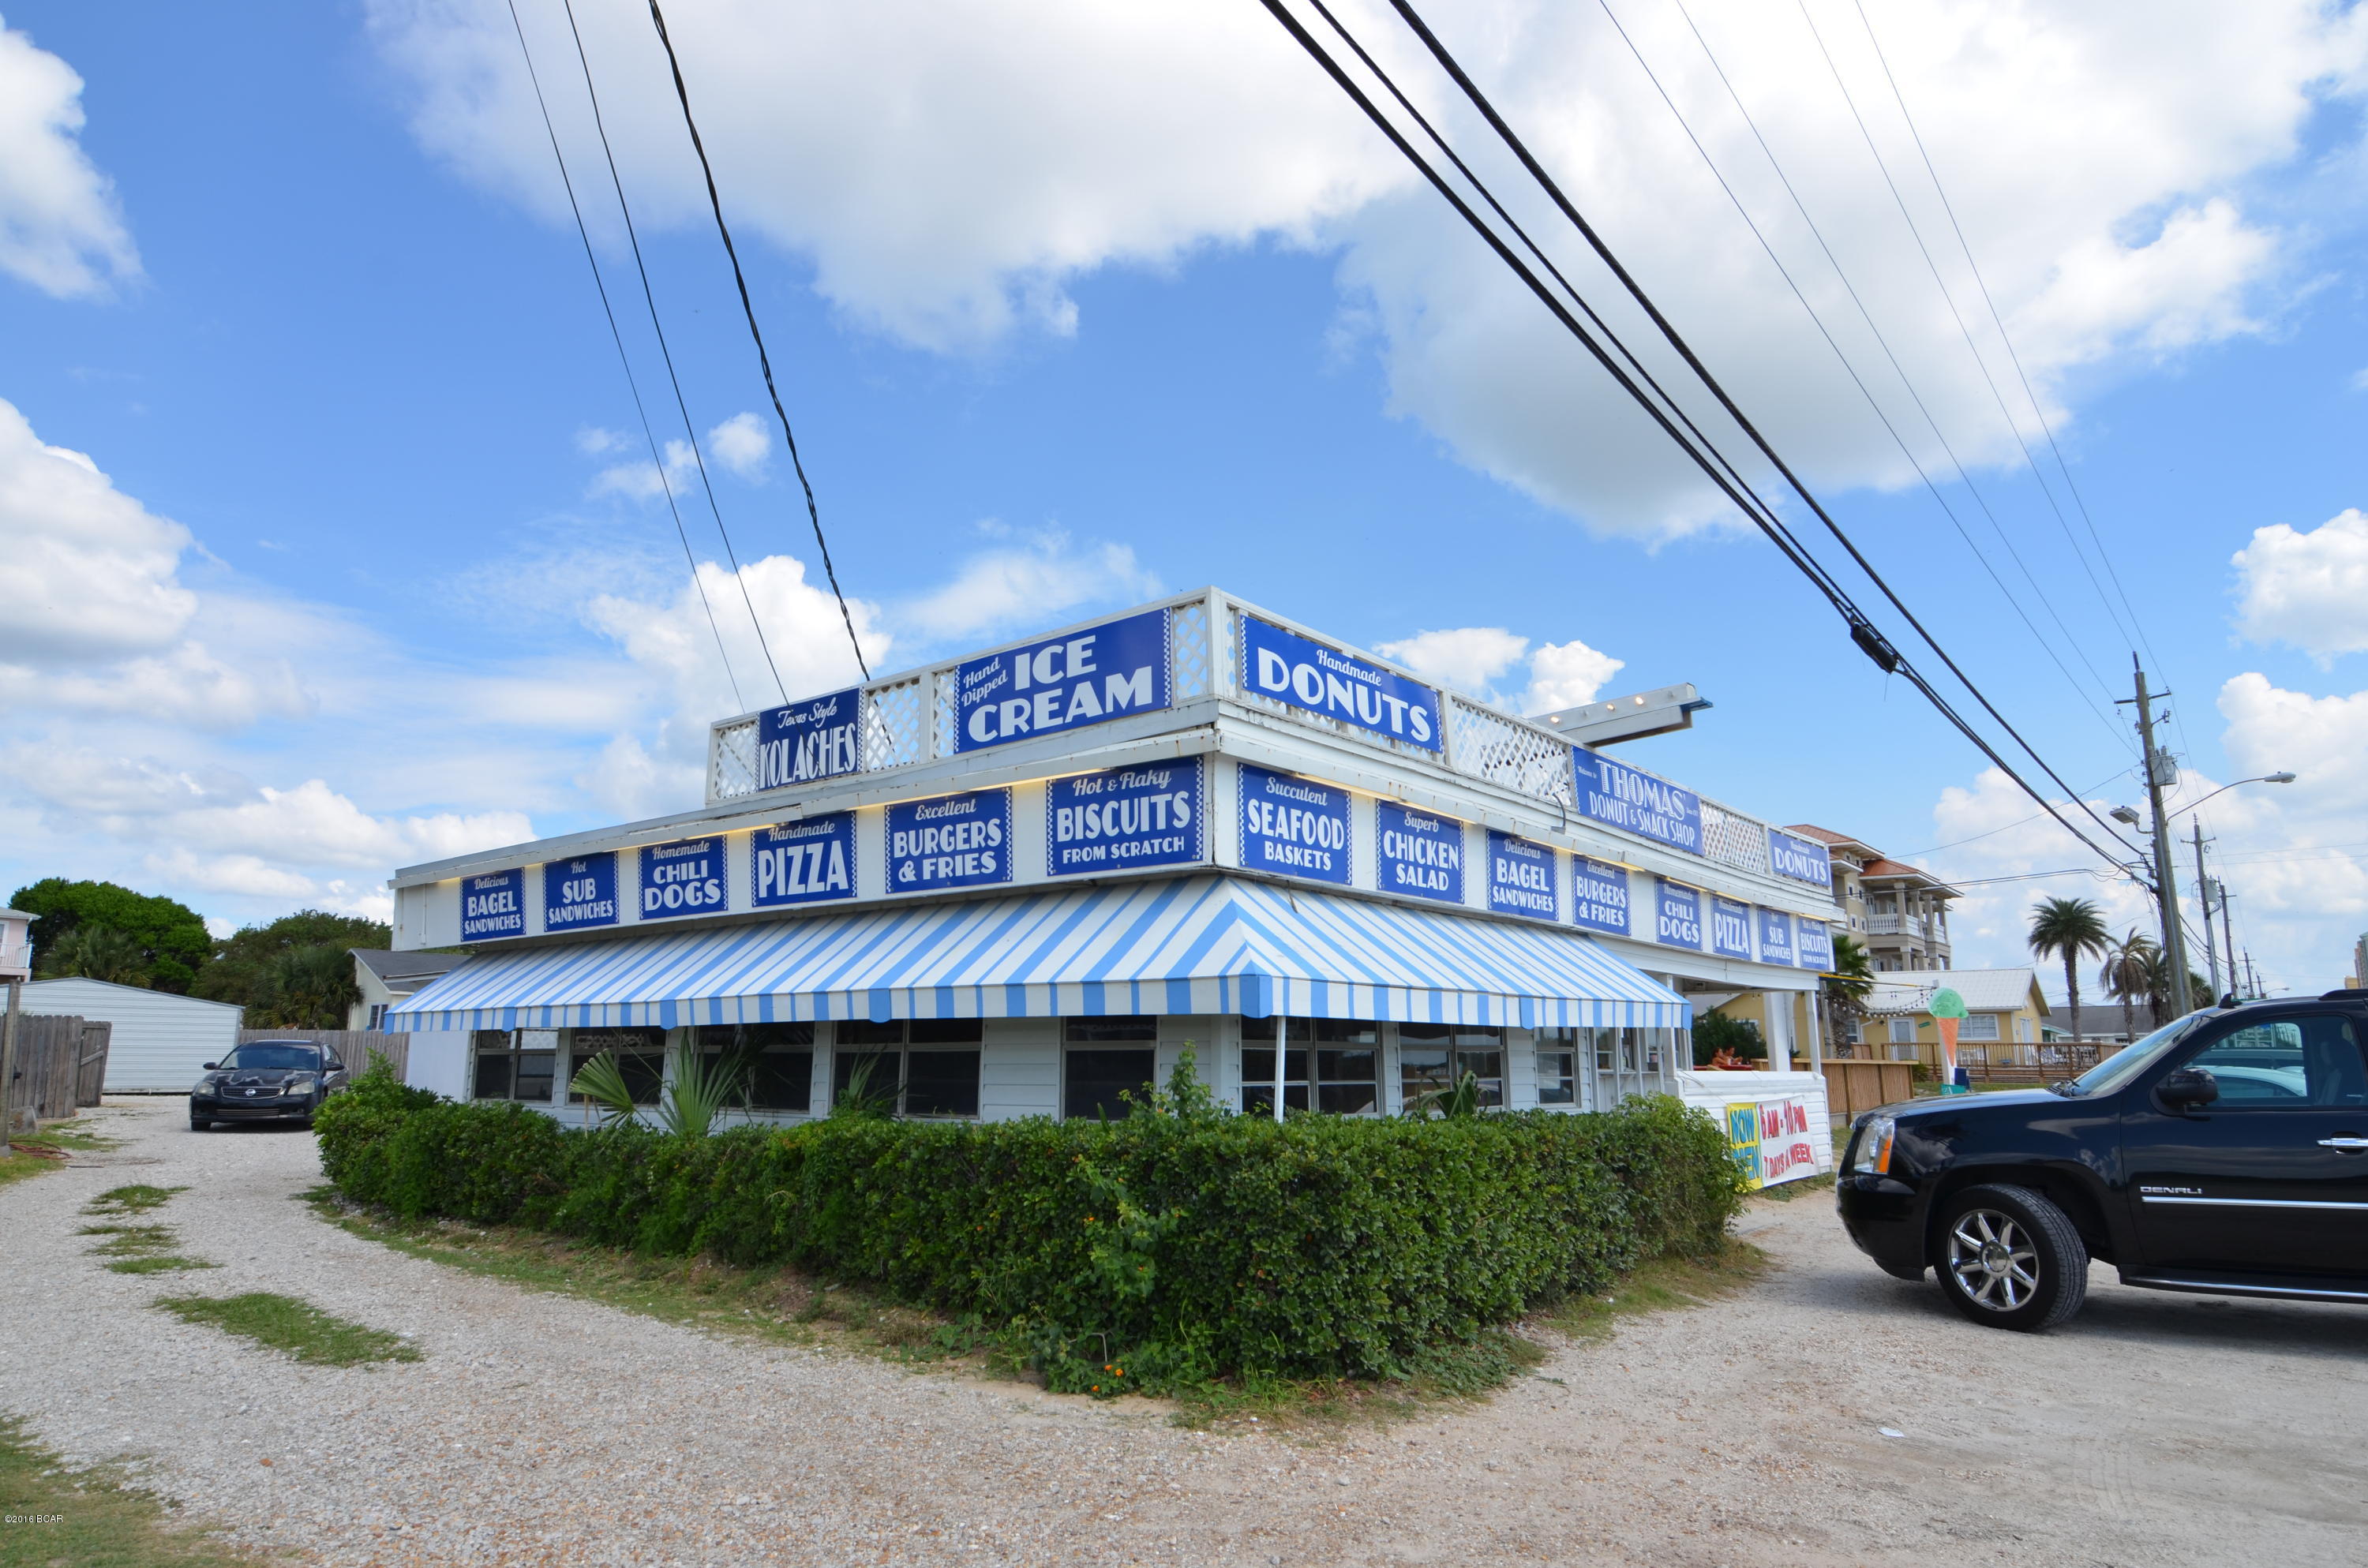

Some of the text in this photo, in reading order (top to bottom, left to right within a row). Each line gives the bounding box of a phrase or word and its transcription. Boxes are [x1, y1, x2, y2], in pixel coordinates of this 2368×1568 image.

[963, 657, 1001, 689] Hand
[1015, 634, 1096, 690] ICE
[1317, 649, 1382, 687] Handmade
[961, 669, 1008, 707] Dipped
[1257, 647, 1431, 742] DONUTS
[777, 697, 837, 729] Texas Style
[968, 665, 1152, 743] CREAM
[759, 723, 856, 789] KOLACHES
[1073, 769, 1172, 797] Hot & Flaky
[1265, 777, 1328, 806] Succulent
[915, 798, 977, 821] Excellent
[1057, 791, 1191, 843] BISCUITS
[1404, 811, 1439, 833] Superb
[1589, 790, 1695, 848] DONUT & SNACK SHOP
[768, 821, 836, 842] Handmade
[894, 818, 1002, 859] BURGERS
[1247, 798, 1344, 851] SEAFOOD
[652, 840, 710, 860] Homemade
[1062, 836, 1185, 864] FROM SCRATCH
[1265, 840, 1332, 871] BASKETS
[1383, 830, 1459, 871] CHICKEN
[1504, 838, 1541, 859] Delicious
[571, 861, 586, 874] Hot
[653, 859, 708, 885] CHILI
[758, 840, 849, 898] PIZZA
[898, 851, 997, 882] & FRIES
[1396, 863, 1449, 891] SALAD
[1496, 858, 1550, 892] BAGEL
[1587, 860, 1615, 879] Excellent
[1774, 846, 1827, 882] DONUTS
[474, 876, 509, 890] Delicious
[563, 878, 596, 904] SUB
[644, 878, 721, 911] DOGS
[1576, 876, 1627, 908] BURGERS
[467, 891, 517, 917] BAGEL
[549, 900, 613, 924] SANDWICHES
[1493, 885, 1553, 912] SANDWICHES
[1665, 900, 1693, 921] CHILI
[464, 914, 521, 934] SANDWICHES
[1579, 901, 1624, 927] & FRIES
[1659, 915, 1699, 943] DOGS
[1714, 912, 1750, 954] PIZZA
[1769, 926, 1784, 945] SUB
[1800, 932, 1827, 954] BISCUITS
[1763, 943, 1791, 960] SANDWICHES
[1730, 1108, 1755, 1144] NOW
[1763, 1143, 1814, 1178] 7 DAYS A WEEK
